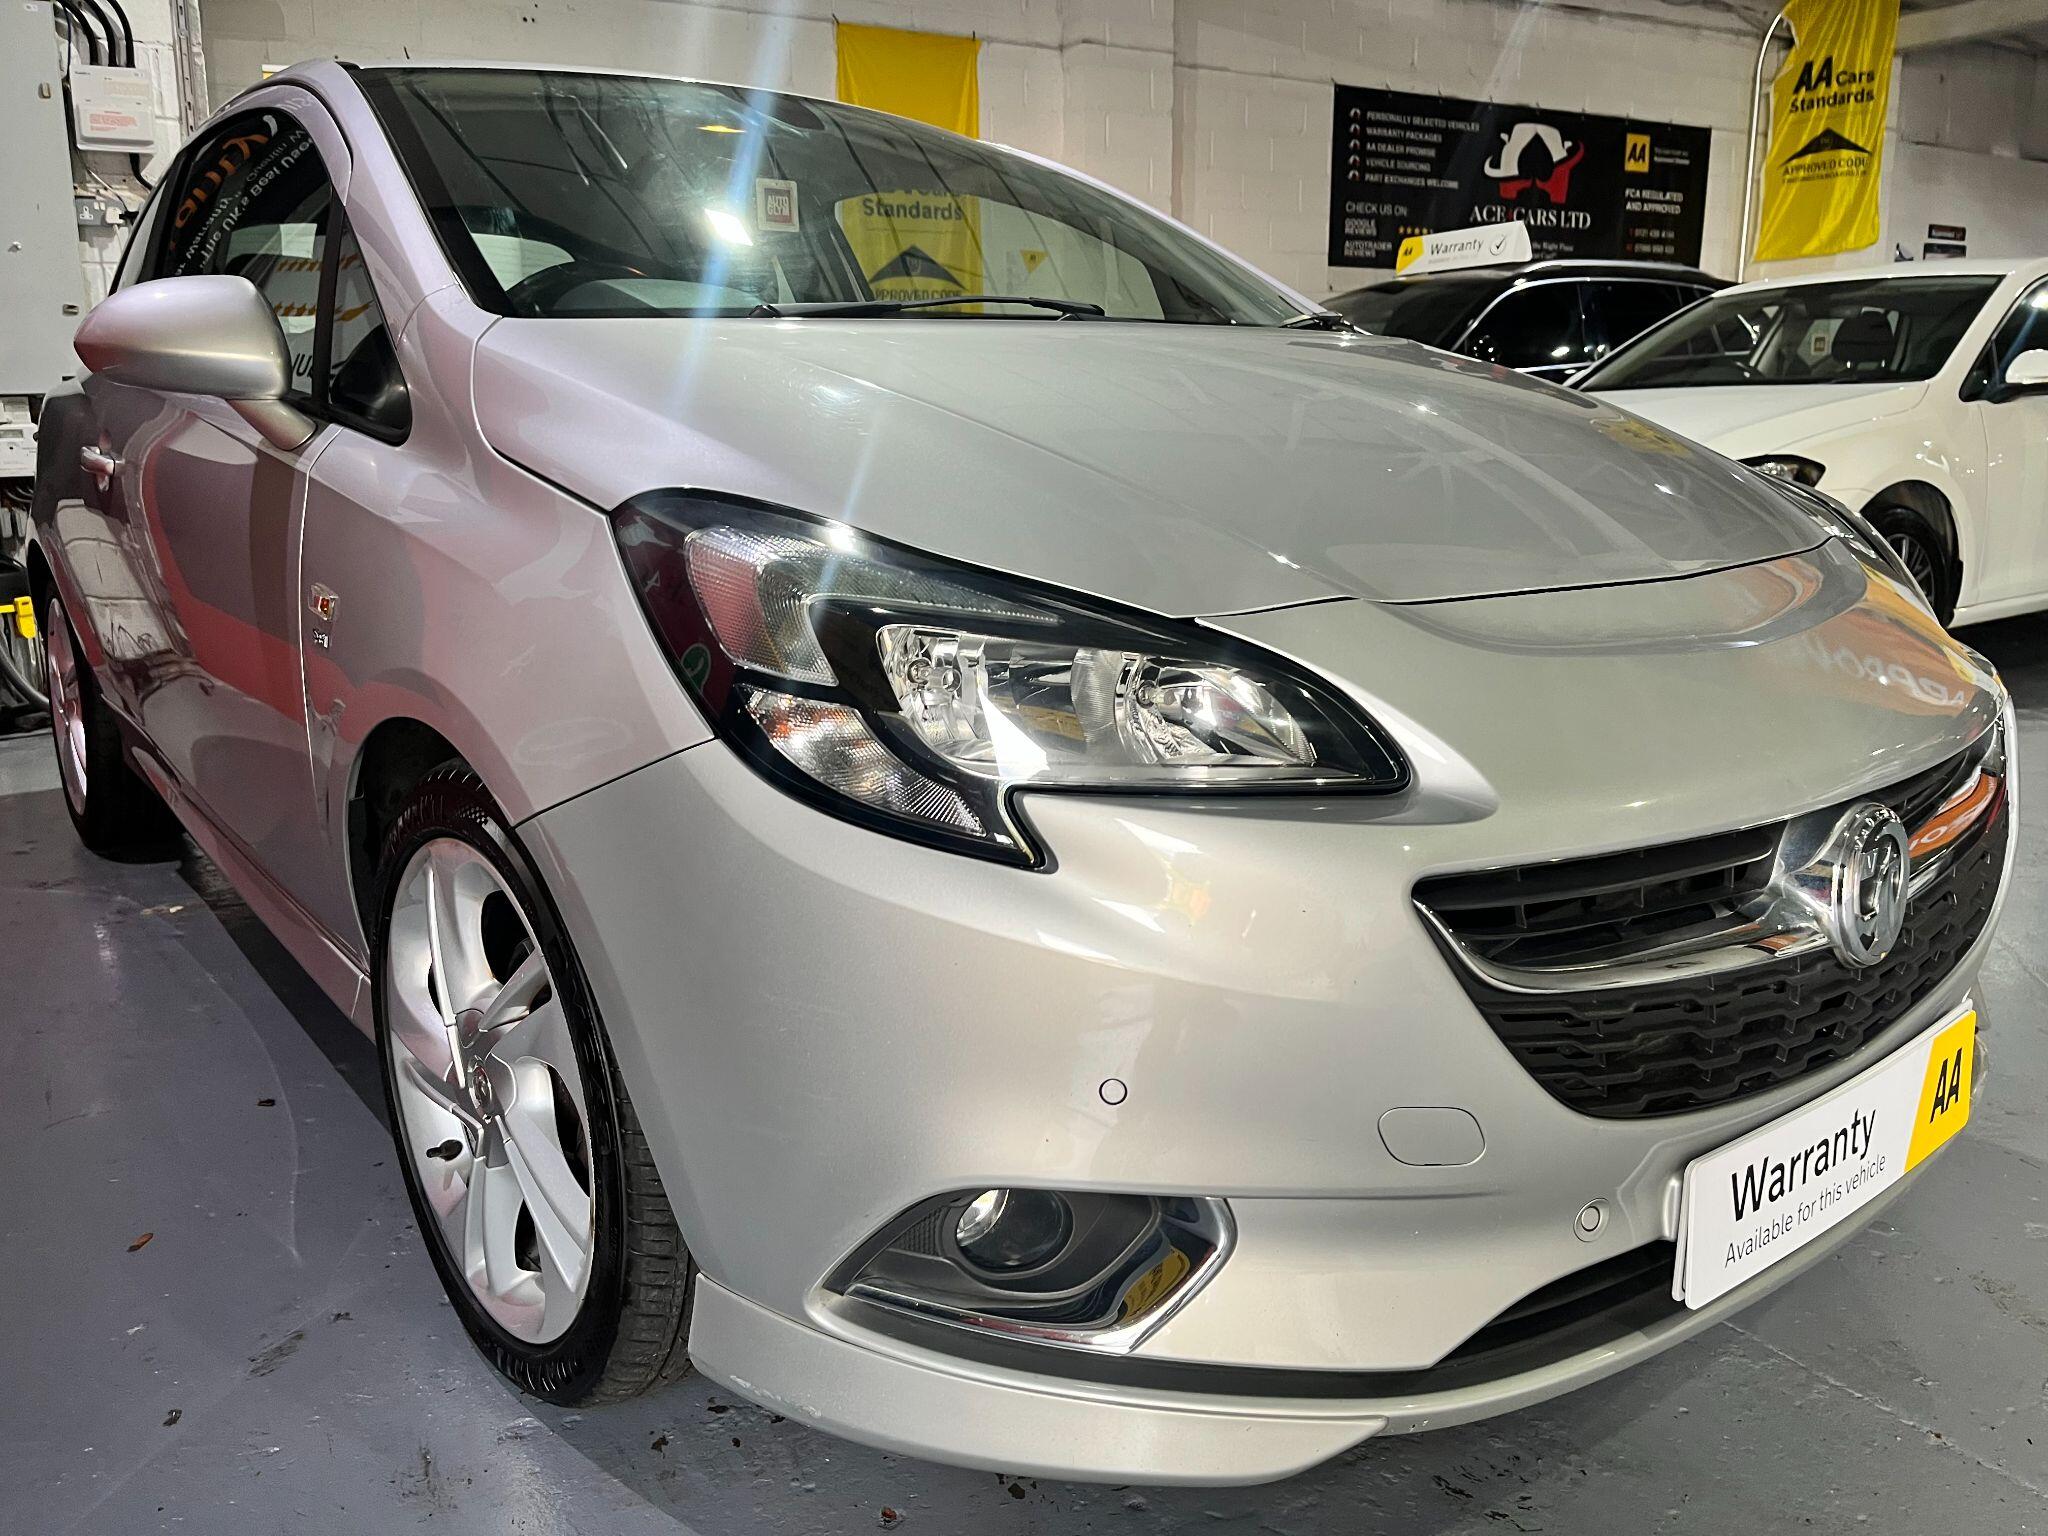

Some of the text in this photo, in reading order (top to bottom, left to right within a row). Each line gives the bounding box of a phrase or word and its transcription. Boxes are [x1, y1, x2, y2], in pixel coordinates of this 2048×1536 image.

[1793, 55, 1875, 95] AA Cars
[1790, 88, 1875, 113] Standards
[1366, 127, 1404, 138] WARRANTY
[1377, 143, 1404, 154] DEALER
[1628, 143, 1647, 162] AA
[1366, 158, 1395, 169] VEHICLE
[862, 198, 963, 220] Standards
[1345, 201, 1408, 217] CHECK US ON
[1470, 205, 1591, 229] ACE CARS LTD
[1431, 238, 1484, 256] Warranty
[1929, 1048, 1962, 1124] AA
[1731, 1108, 1876, 1222] Warranty
[1724, 1153, 1886, 1268] Available for this vehicle
